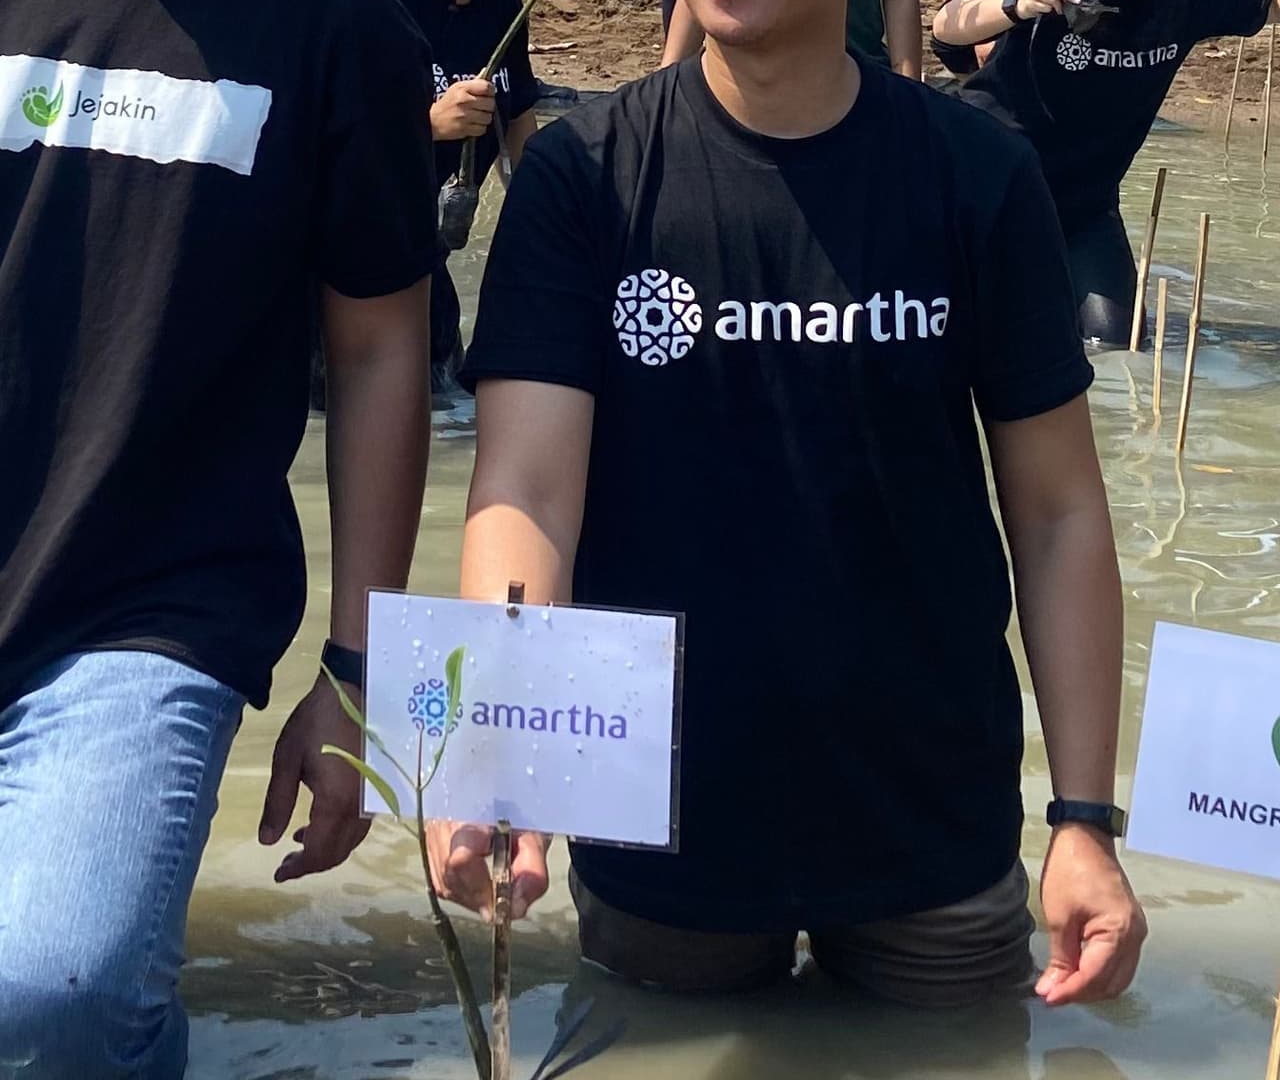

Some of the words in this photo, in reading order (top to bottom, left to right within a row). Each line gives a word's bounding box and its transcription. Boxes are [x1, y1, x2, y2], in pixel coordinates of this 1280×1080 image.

[68, 89, 156, 121] Jejakin
[715, 289, 951, 343] amartha
[471, 700, 628, 740] amartha
